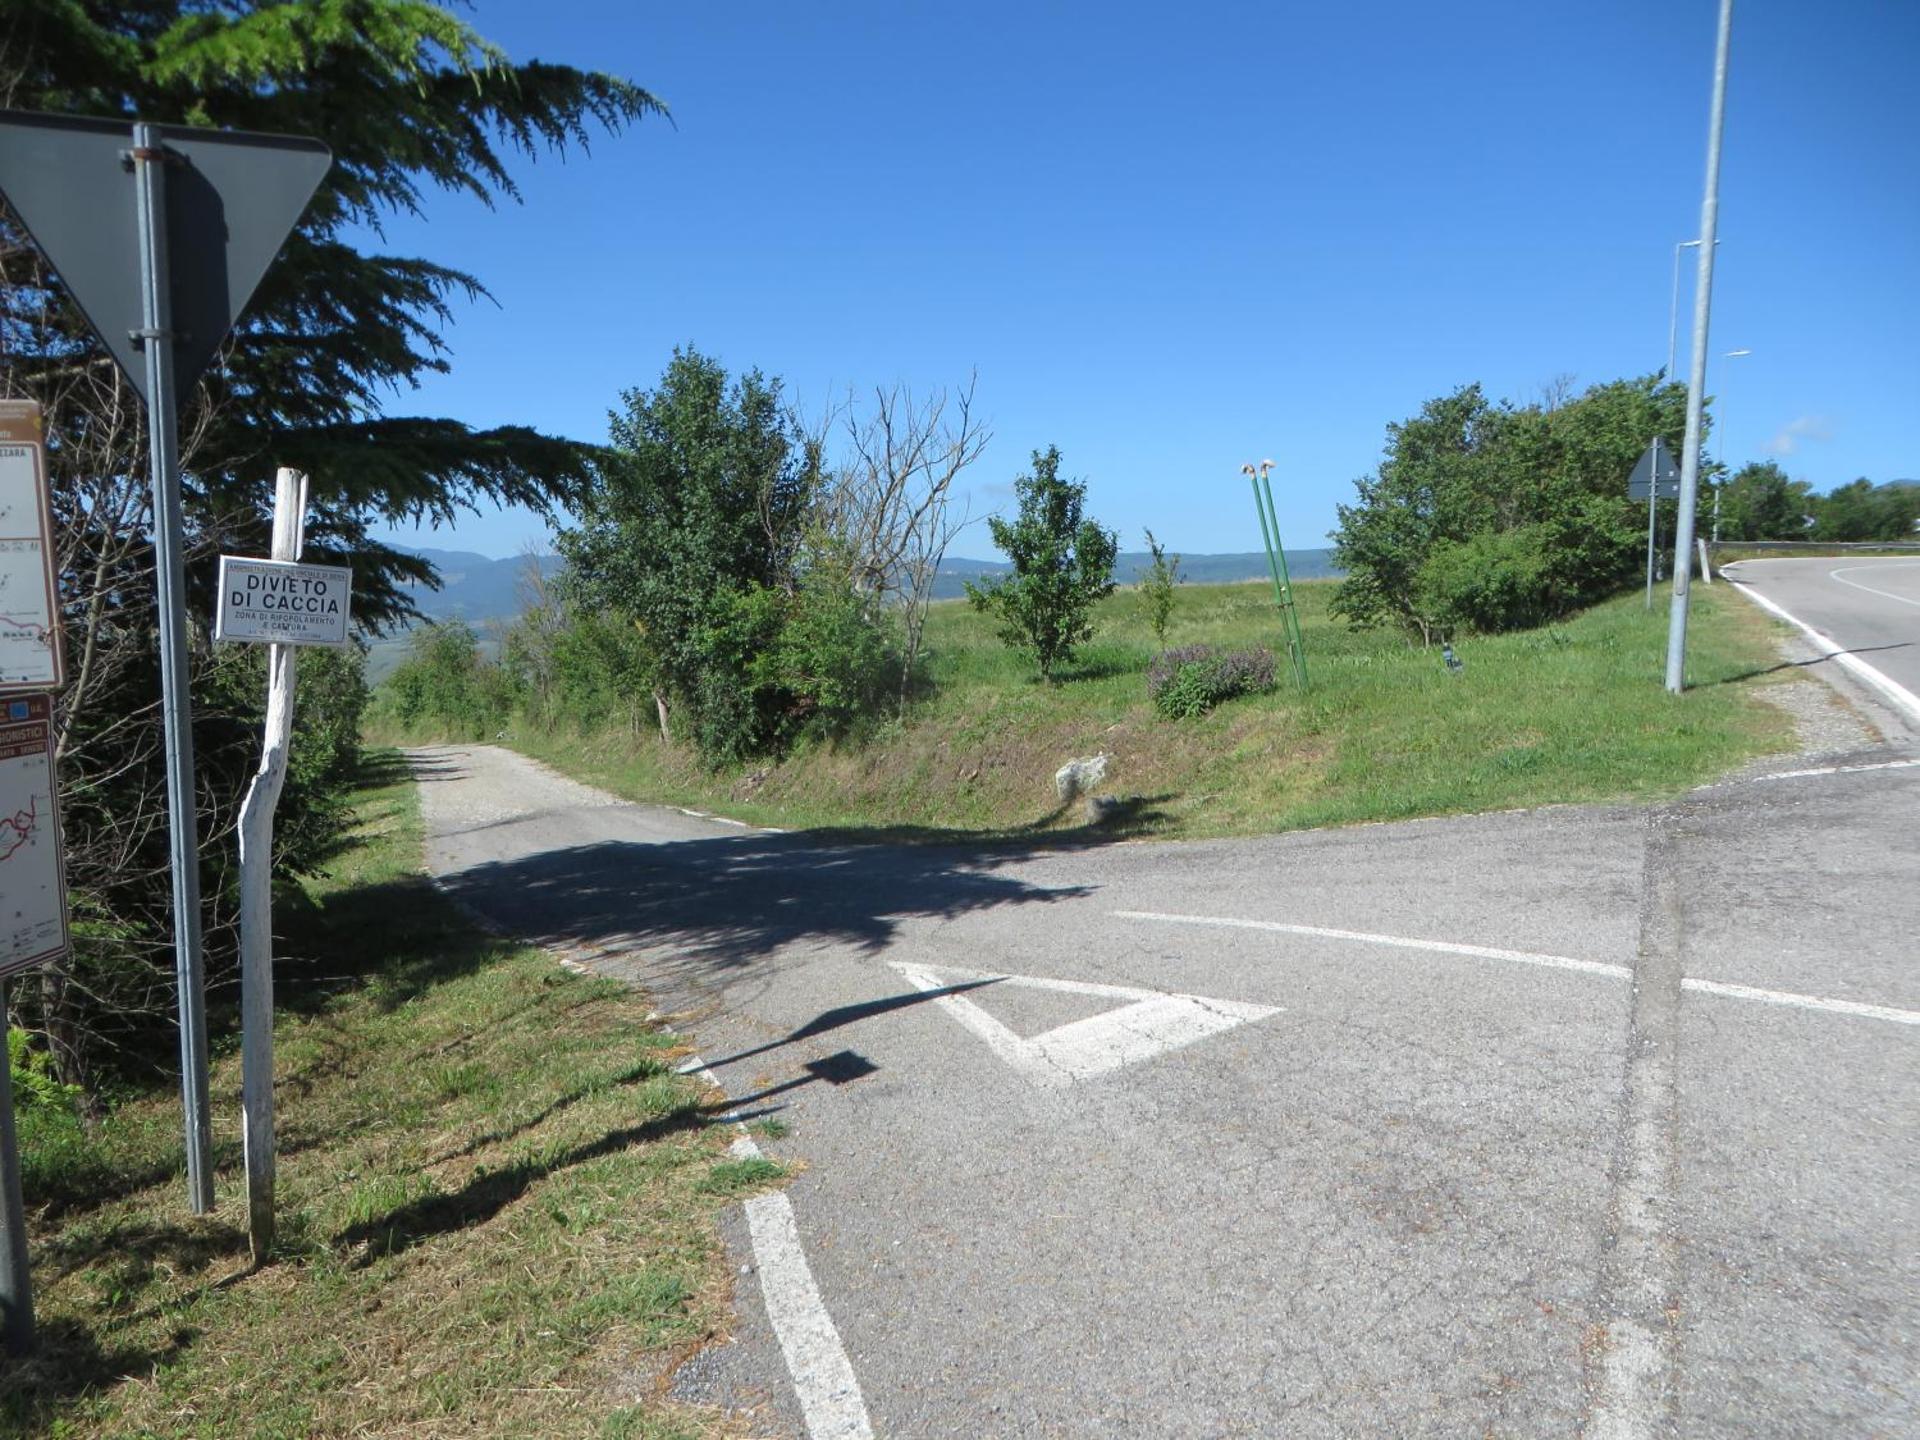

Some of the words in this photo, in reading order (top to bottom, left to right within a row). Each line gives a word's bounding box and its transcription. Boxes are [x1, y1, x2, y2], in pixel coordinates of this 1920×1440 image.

[247, 574, 327, 596] DIVIETO
[231, 591, 250, 607] DI
[263, 594, 338, 614] CACCIA
[235, 611, 255, 620] ZONA
[259, 613, 268, 621] DI
[270, 613, 335, 625] RIPOPOLAMENTO
